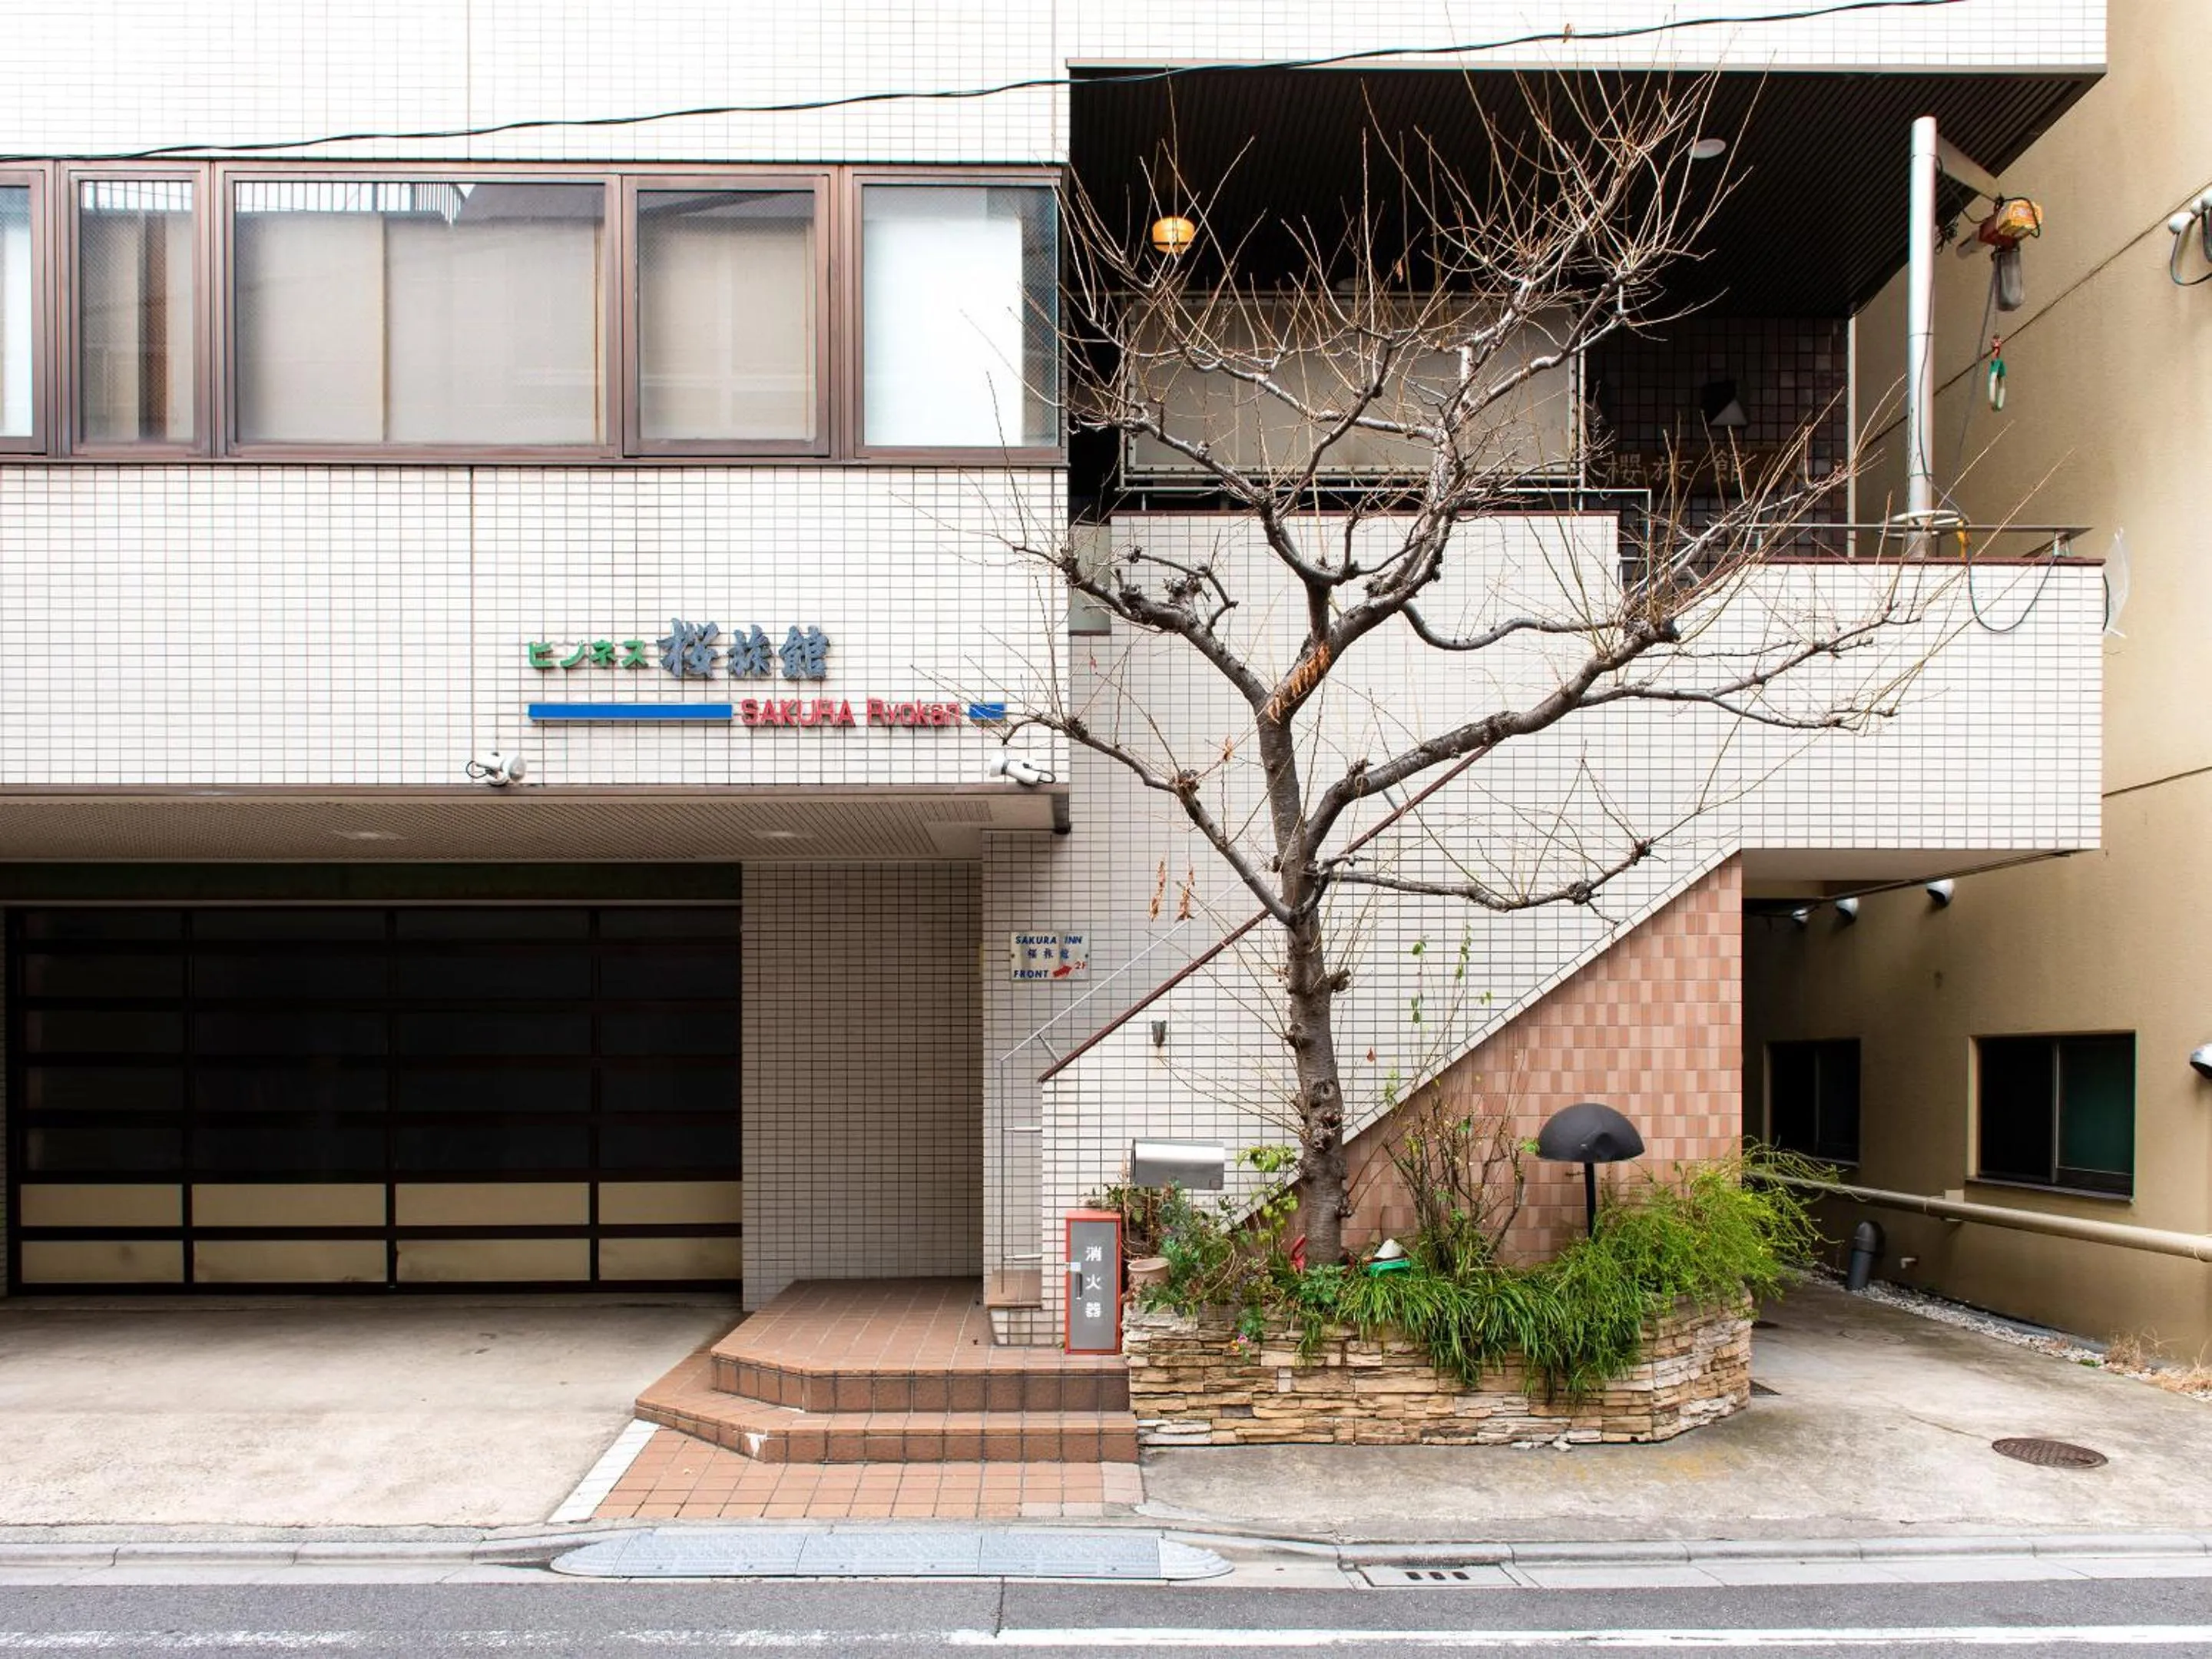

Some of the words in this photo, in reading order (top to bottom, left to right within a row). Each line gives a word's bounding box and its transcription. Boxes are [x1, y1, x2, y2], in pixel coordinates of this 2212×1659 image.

[740, 698, 856, 727] SAKURA
[1015, 935, 1057, 944] SAKURA
[1065, 935, 1083, 944] INN
[1014, 970, 1049, 979] FRONT
[1085, 1246, 1103, 1318] 消火器
